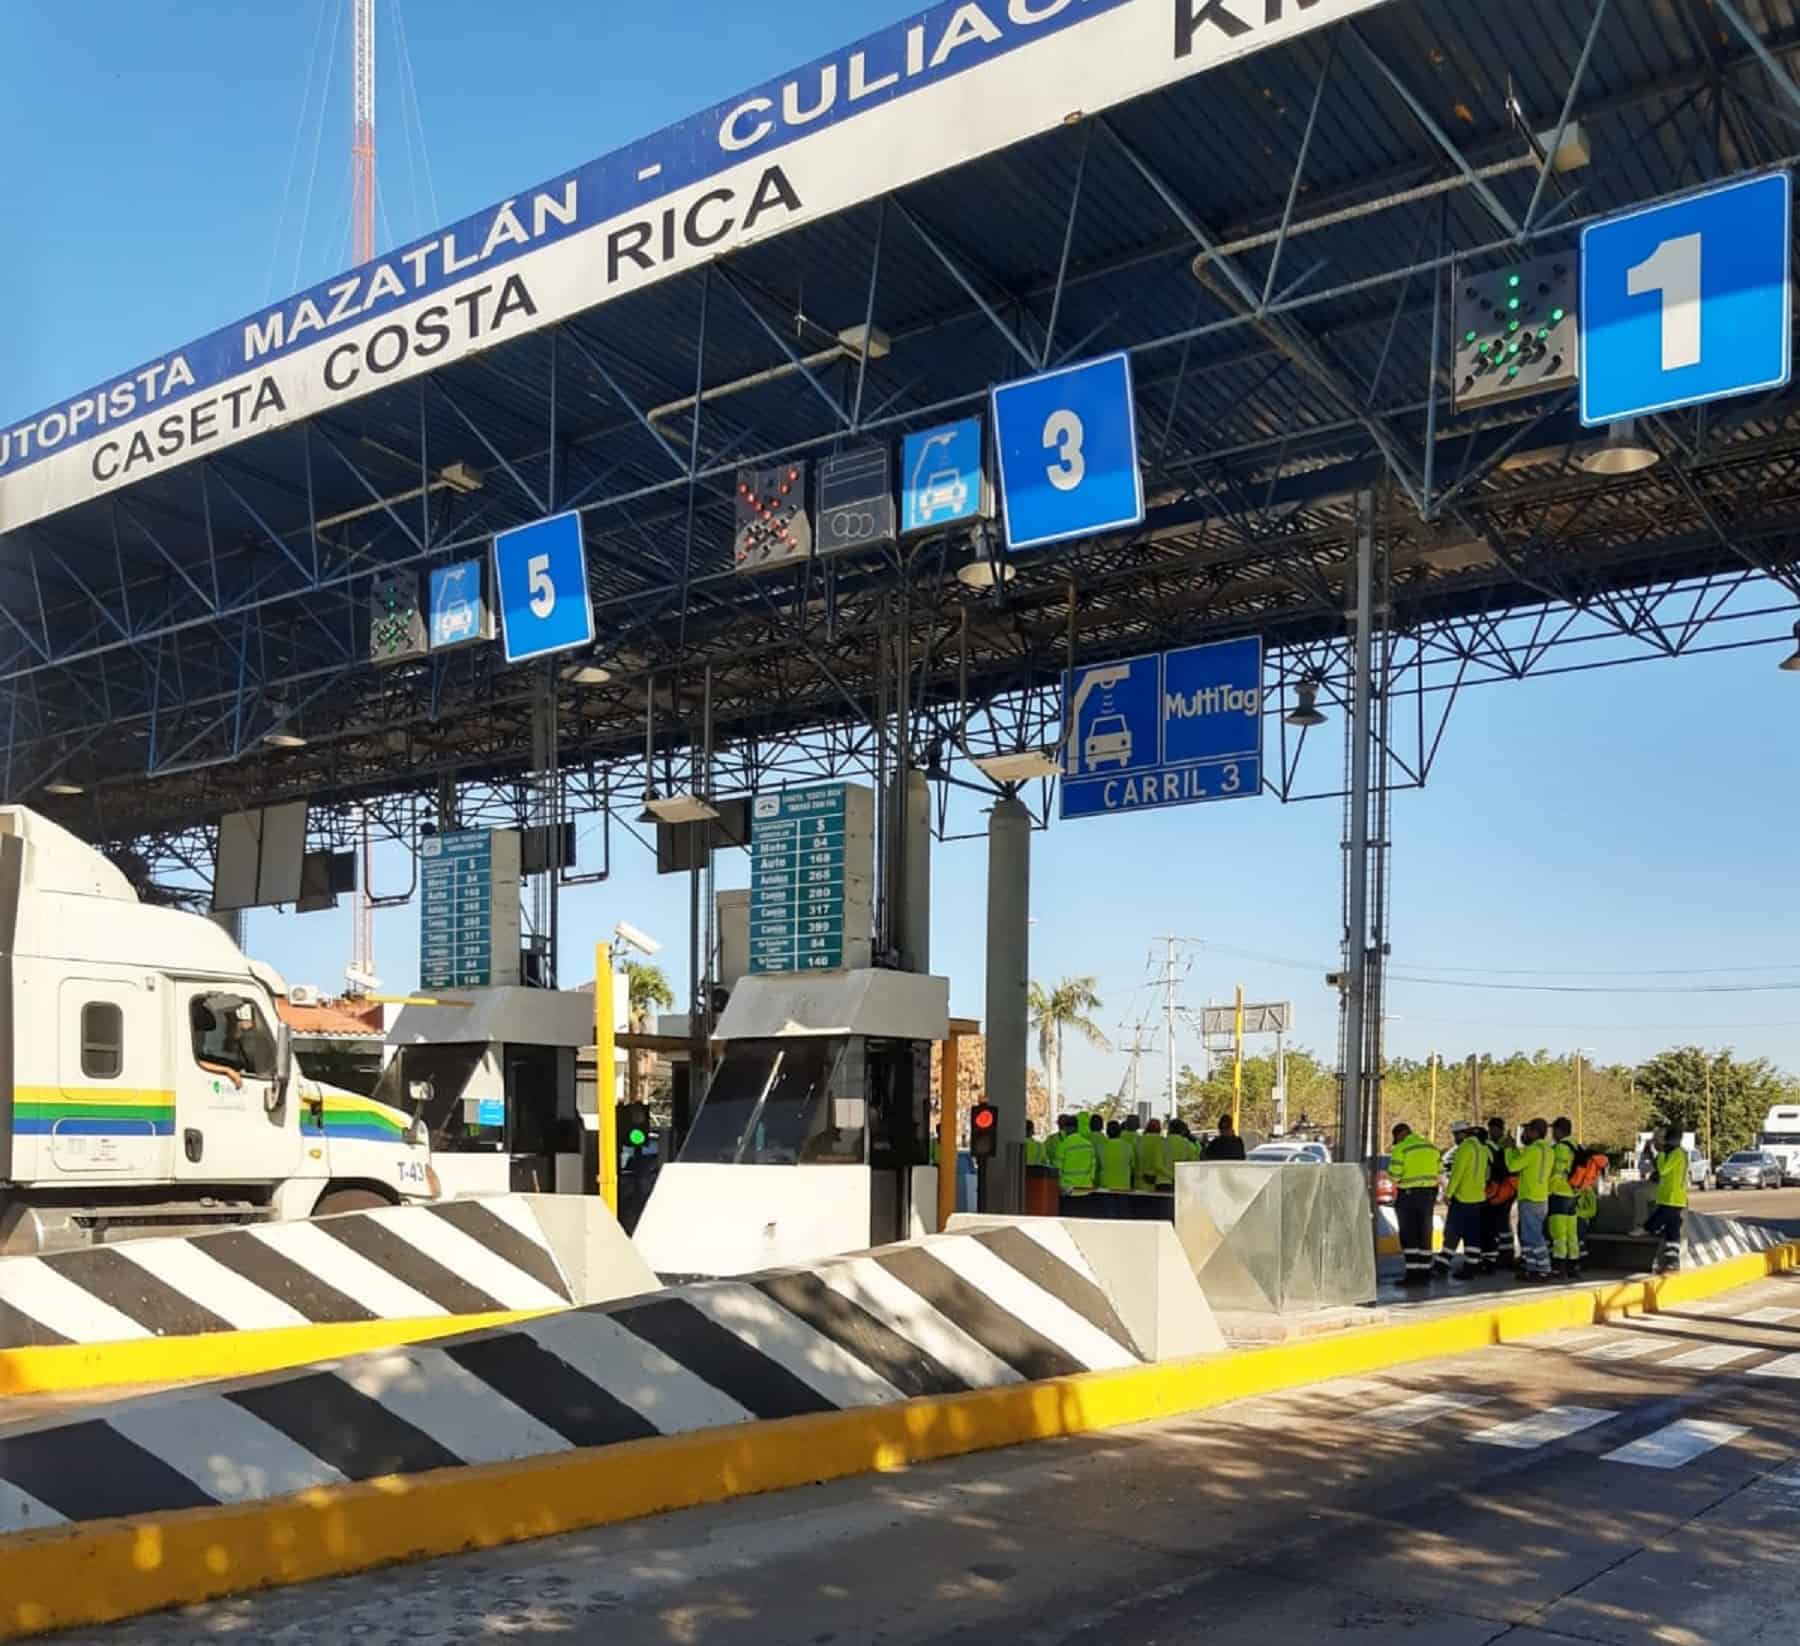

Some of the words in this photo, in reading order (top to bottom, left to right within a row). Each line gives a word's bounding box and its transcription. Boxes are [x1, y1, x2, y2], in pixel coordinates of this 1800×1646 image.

[244, 180, 578, 361] MAZATLÁN
[1627, 231, 1702, 371] 1
[92, 375, 286, 482] CASETA
[323, 274, 538, 391] COSTA
[606, 165, 802, 282] RICA
[1041, 410, 1085, 491] 3
[527, 553, 558, 619] 5
[1163, 684, 1260, 720] MultiTag
[1103, 769, 1207, 808] CARRIL
[1221, 764, 1240, 791] 3
[808, 904, 831, 915] 317
